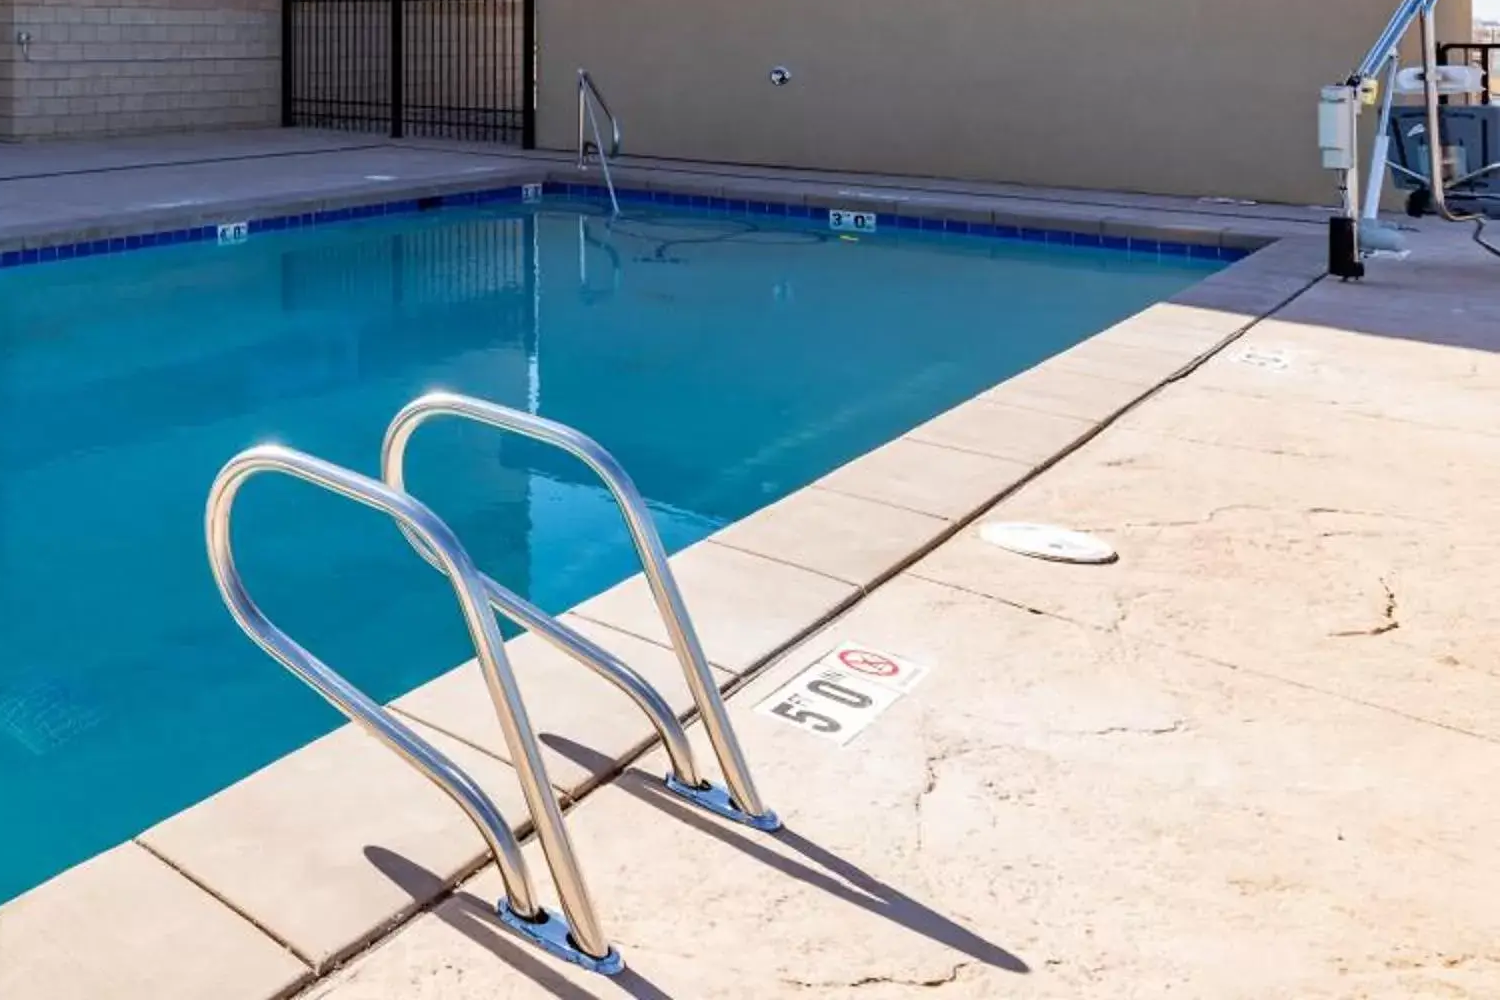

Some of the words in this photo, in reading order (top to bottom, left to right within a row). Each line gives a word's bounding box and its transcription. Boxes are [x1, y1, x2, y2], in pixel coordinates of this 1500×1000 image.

[832, 212, 842, 226] 3
[854, 215, 866, 228] 0
[806, 679, 874, 709] 0
[771, 702, 842, 733] 5
